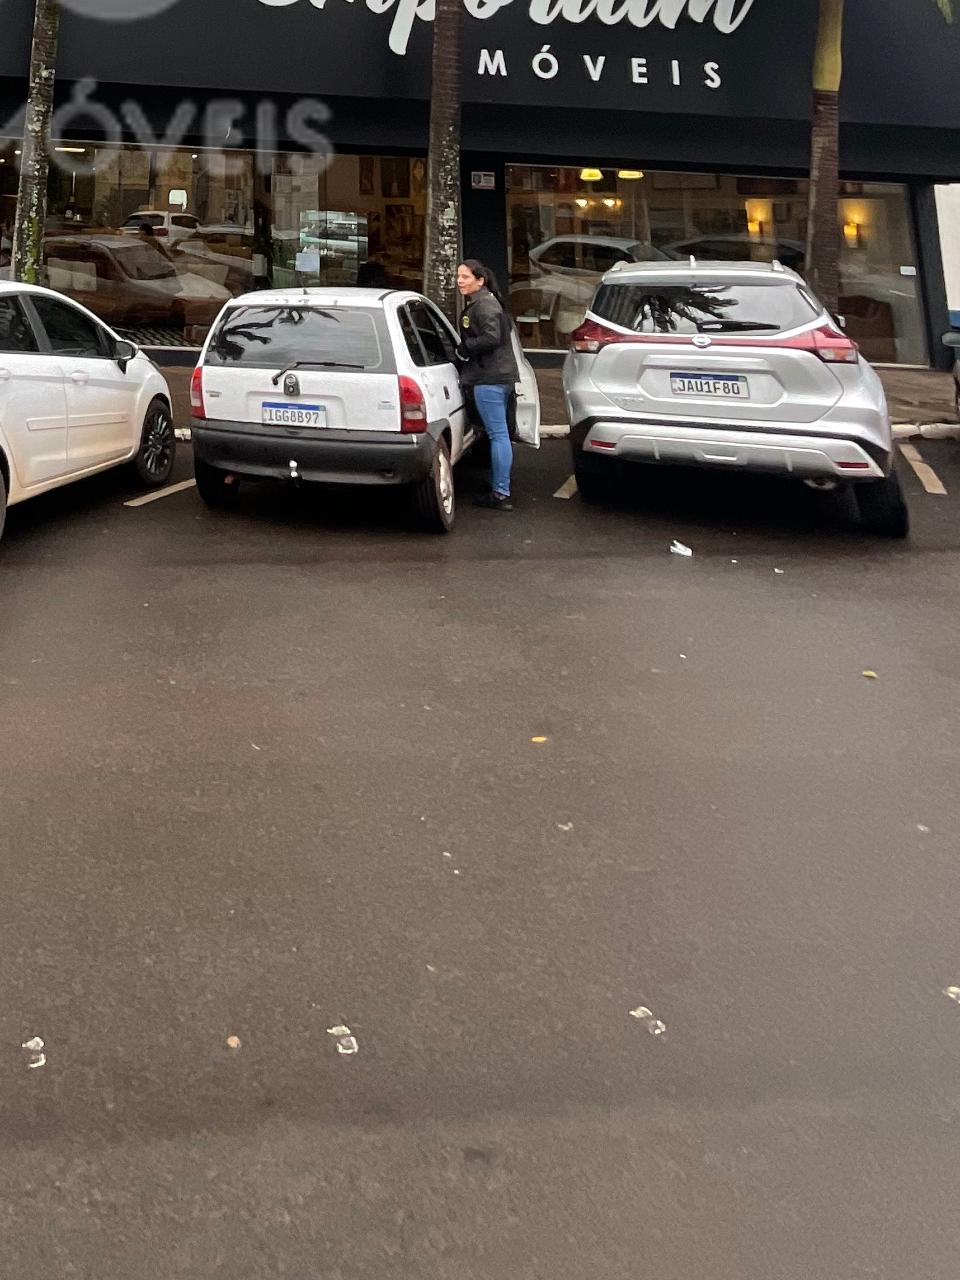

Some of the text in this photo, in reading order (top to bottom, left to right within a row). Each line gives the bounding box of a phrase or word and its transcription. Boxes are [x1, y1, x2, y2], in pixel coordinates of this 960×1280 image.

[477, 44, 722, 89] MÓVEIS
[677, 379, 740, 395] JAU1F80
[267, 409, 320, 424] IGG8B97
